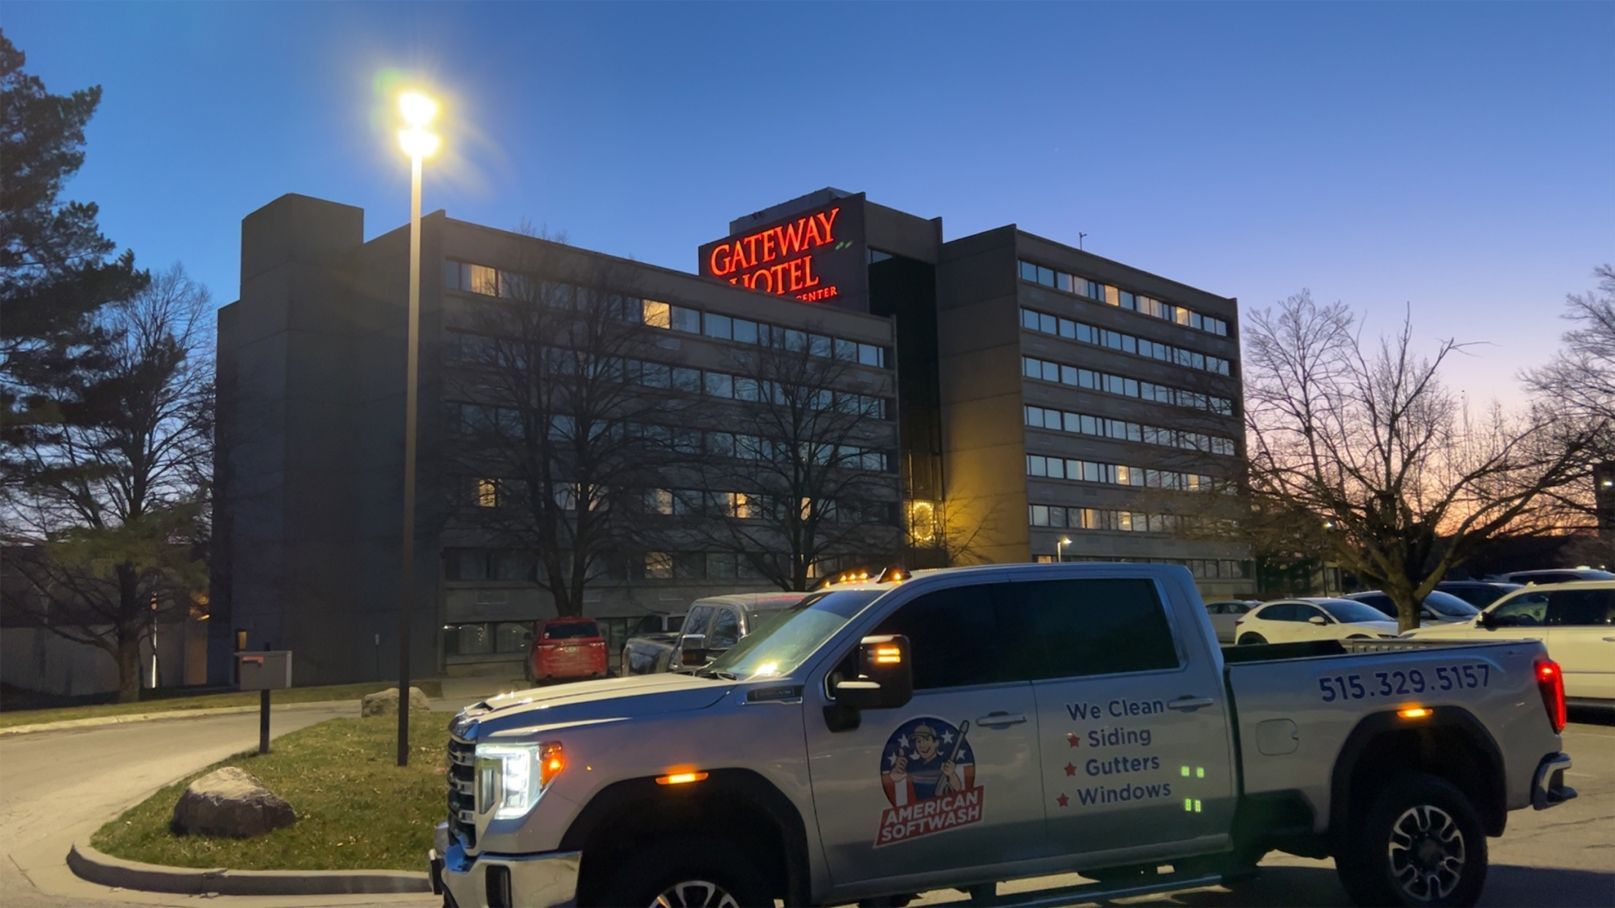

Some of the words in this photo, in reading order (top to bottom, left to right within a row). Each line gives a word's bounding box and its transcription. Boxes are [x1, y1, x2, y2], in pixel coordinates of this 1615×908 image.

[710, 207, 840, 276] GATEWAY
[1319, 664, 1490, 702] 515.329.5157
[1066, 701, 1101, 721] We
[1108, 698, 1164, 717] Clean
[1087, 727, 1151, 748] Siding
[1085, 755, 1160, 777] Gutters
[885, 790, 978, 826] AMERICAN
[1077, 782, 1172, 806] Windows
[881, 805, 980, 842] SOFTWASH
